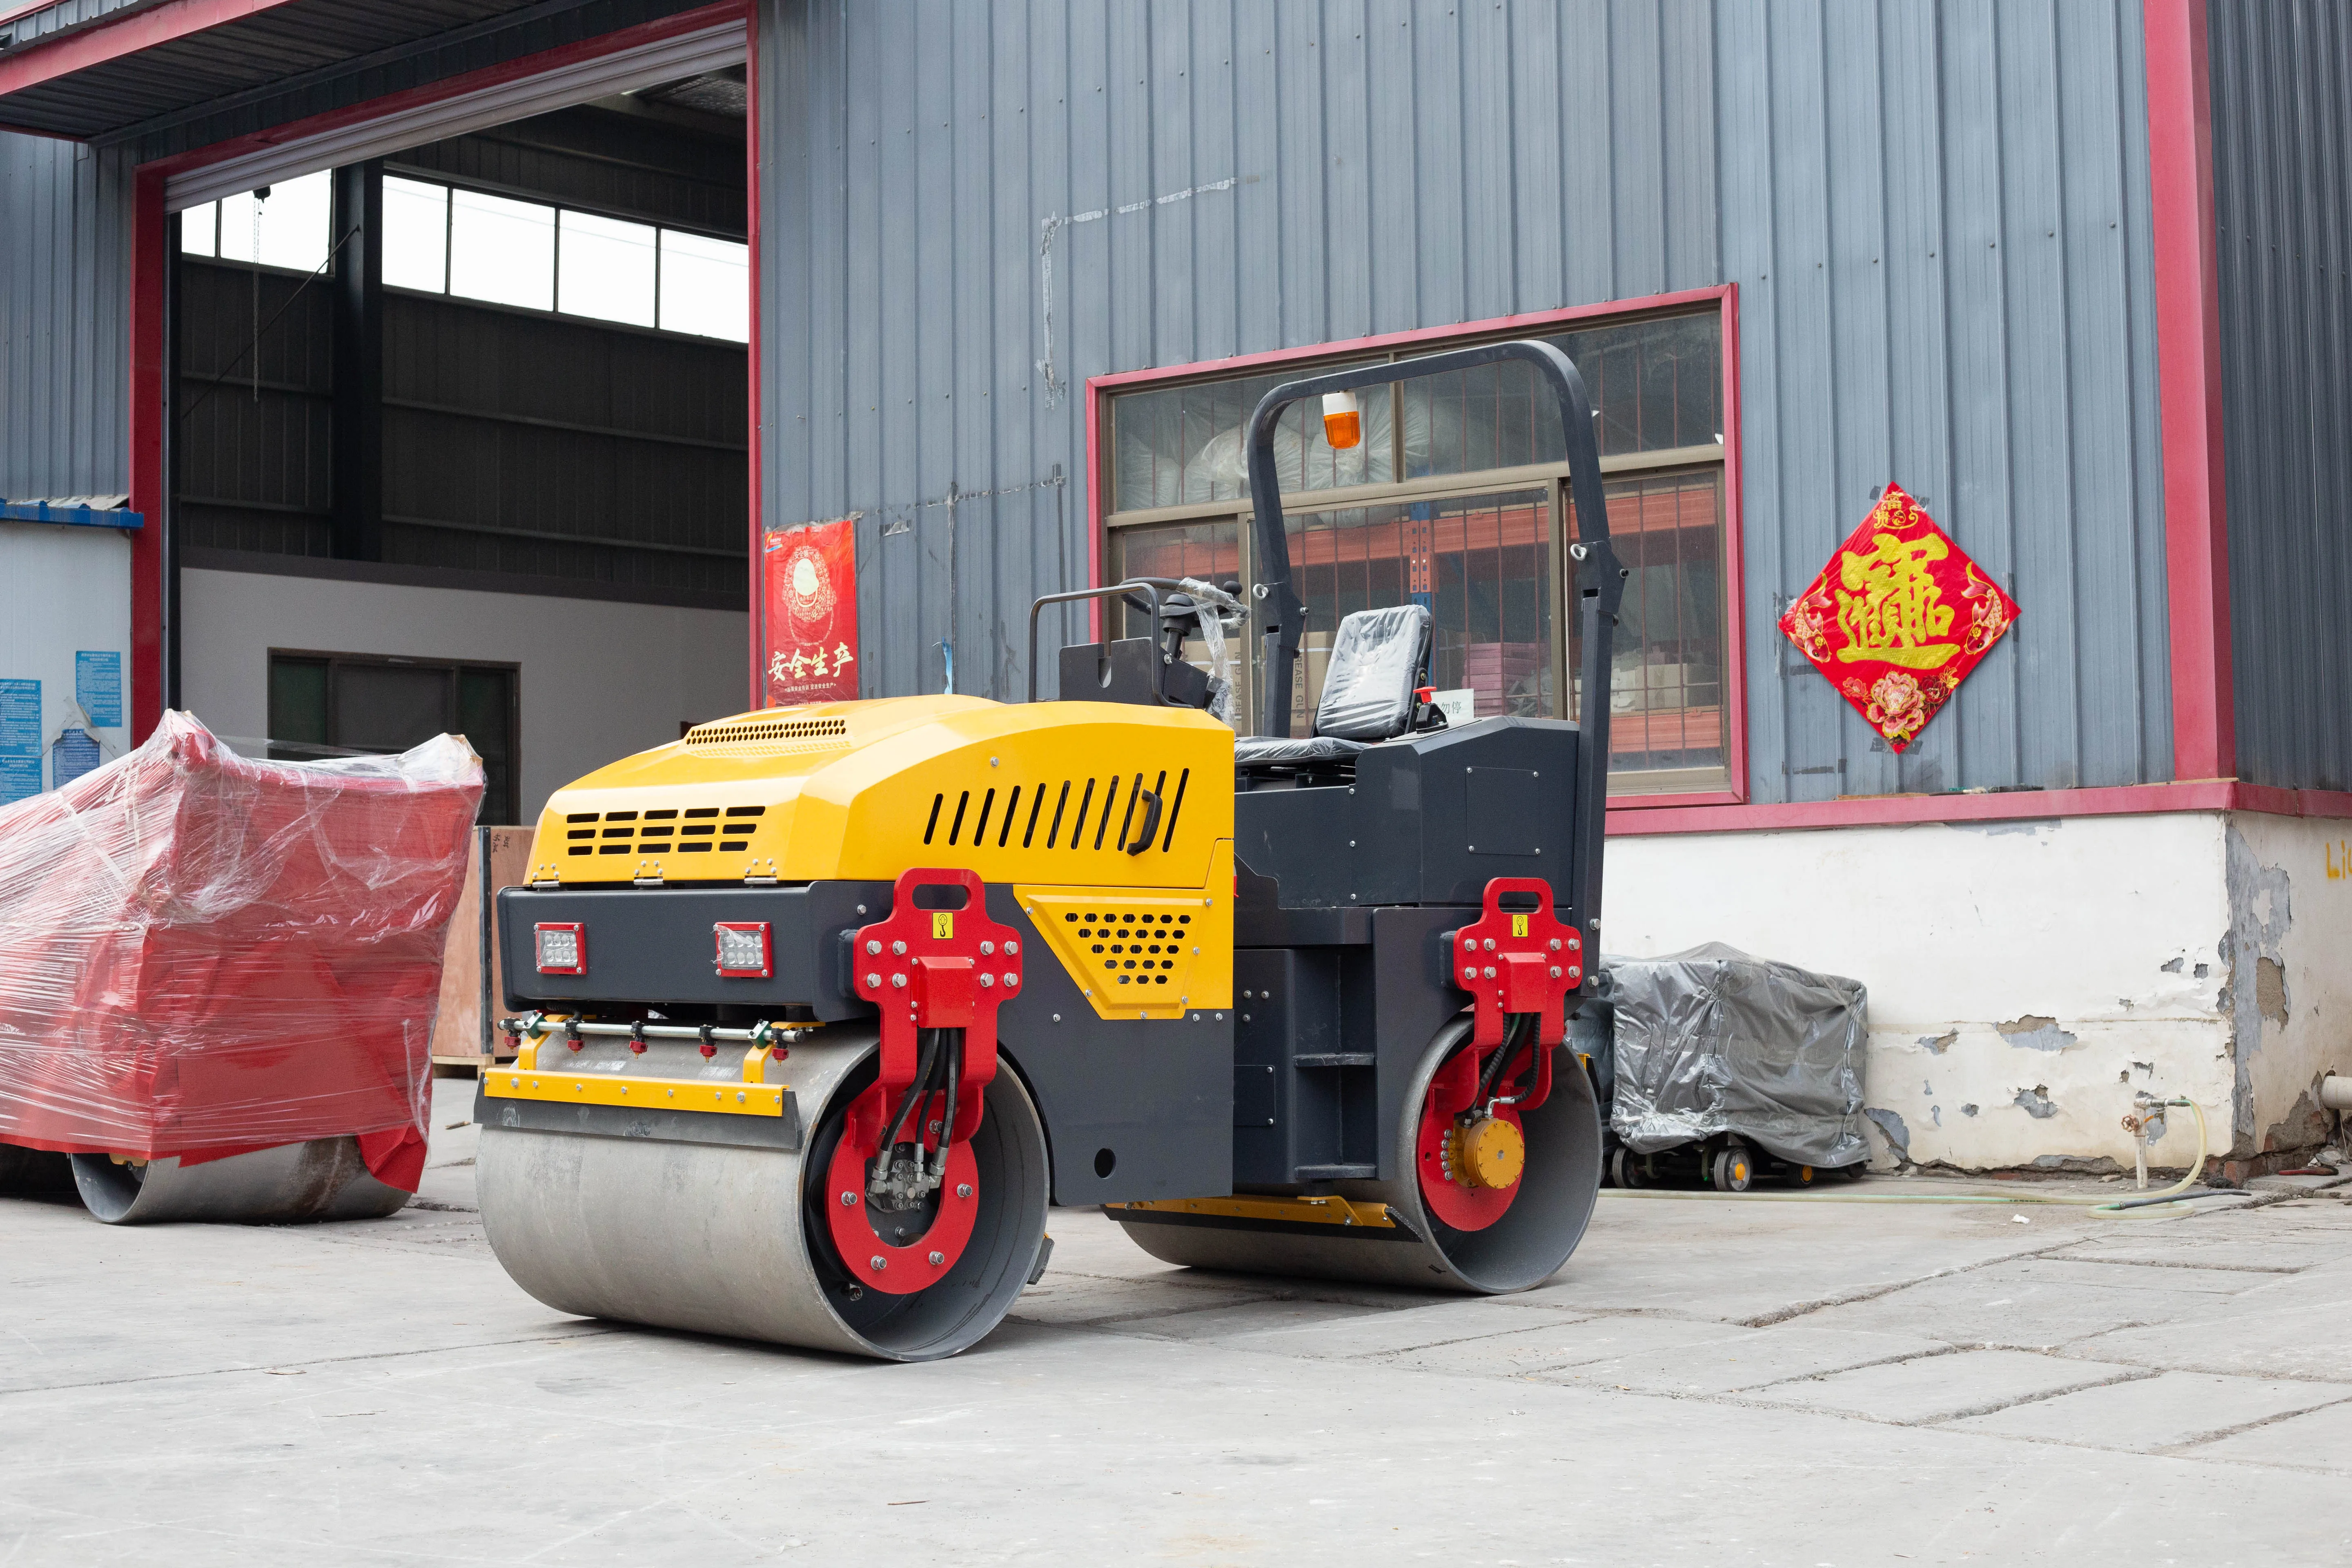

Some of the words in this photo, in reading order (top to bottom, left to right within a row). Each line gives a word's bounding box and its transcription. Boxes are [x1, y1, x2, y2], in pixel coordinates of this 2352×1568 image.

[768, 642, 853, 682] 安全生产
[1294, 653, 1303, 689] REASE
[1438, 701, 1461, 714] 勿停
